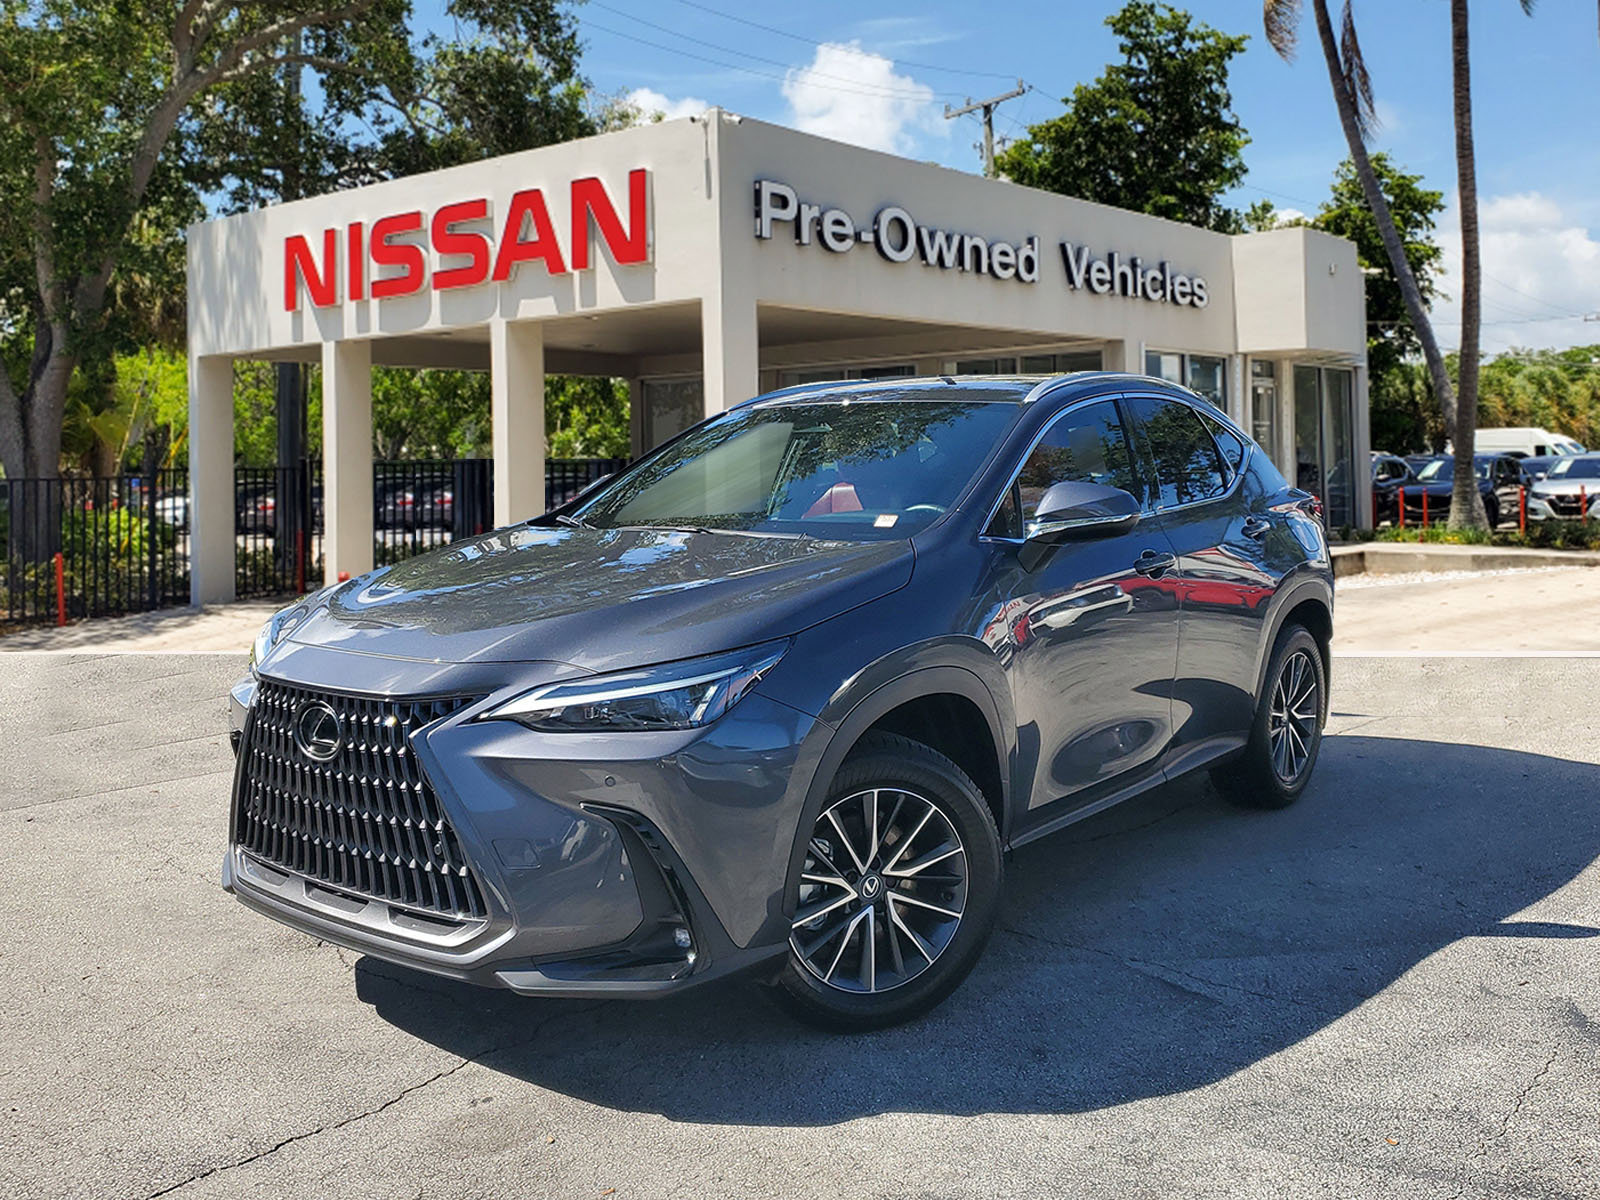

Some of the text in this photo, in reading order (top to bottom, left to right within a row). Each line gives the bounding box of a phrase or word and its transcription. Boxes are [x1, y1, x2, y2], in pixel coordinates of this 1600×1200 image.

[284, 168, 651, 312] NISSAN
[755, 179, 1209, 308] Pre-Owned Vehicles
